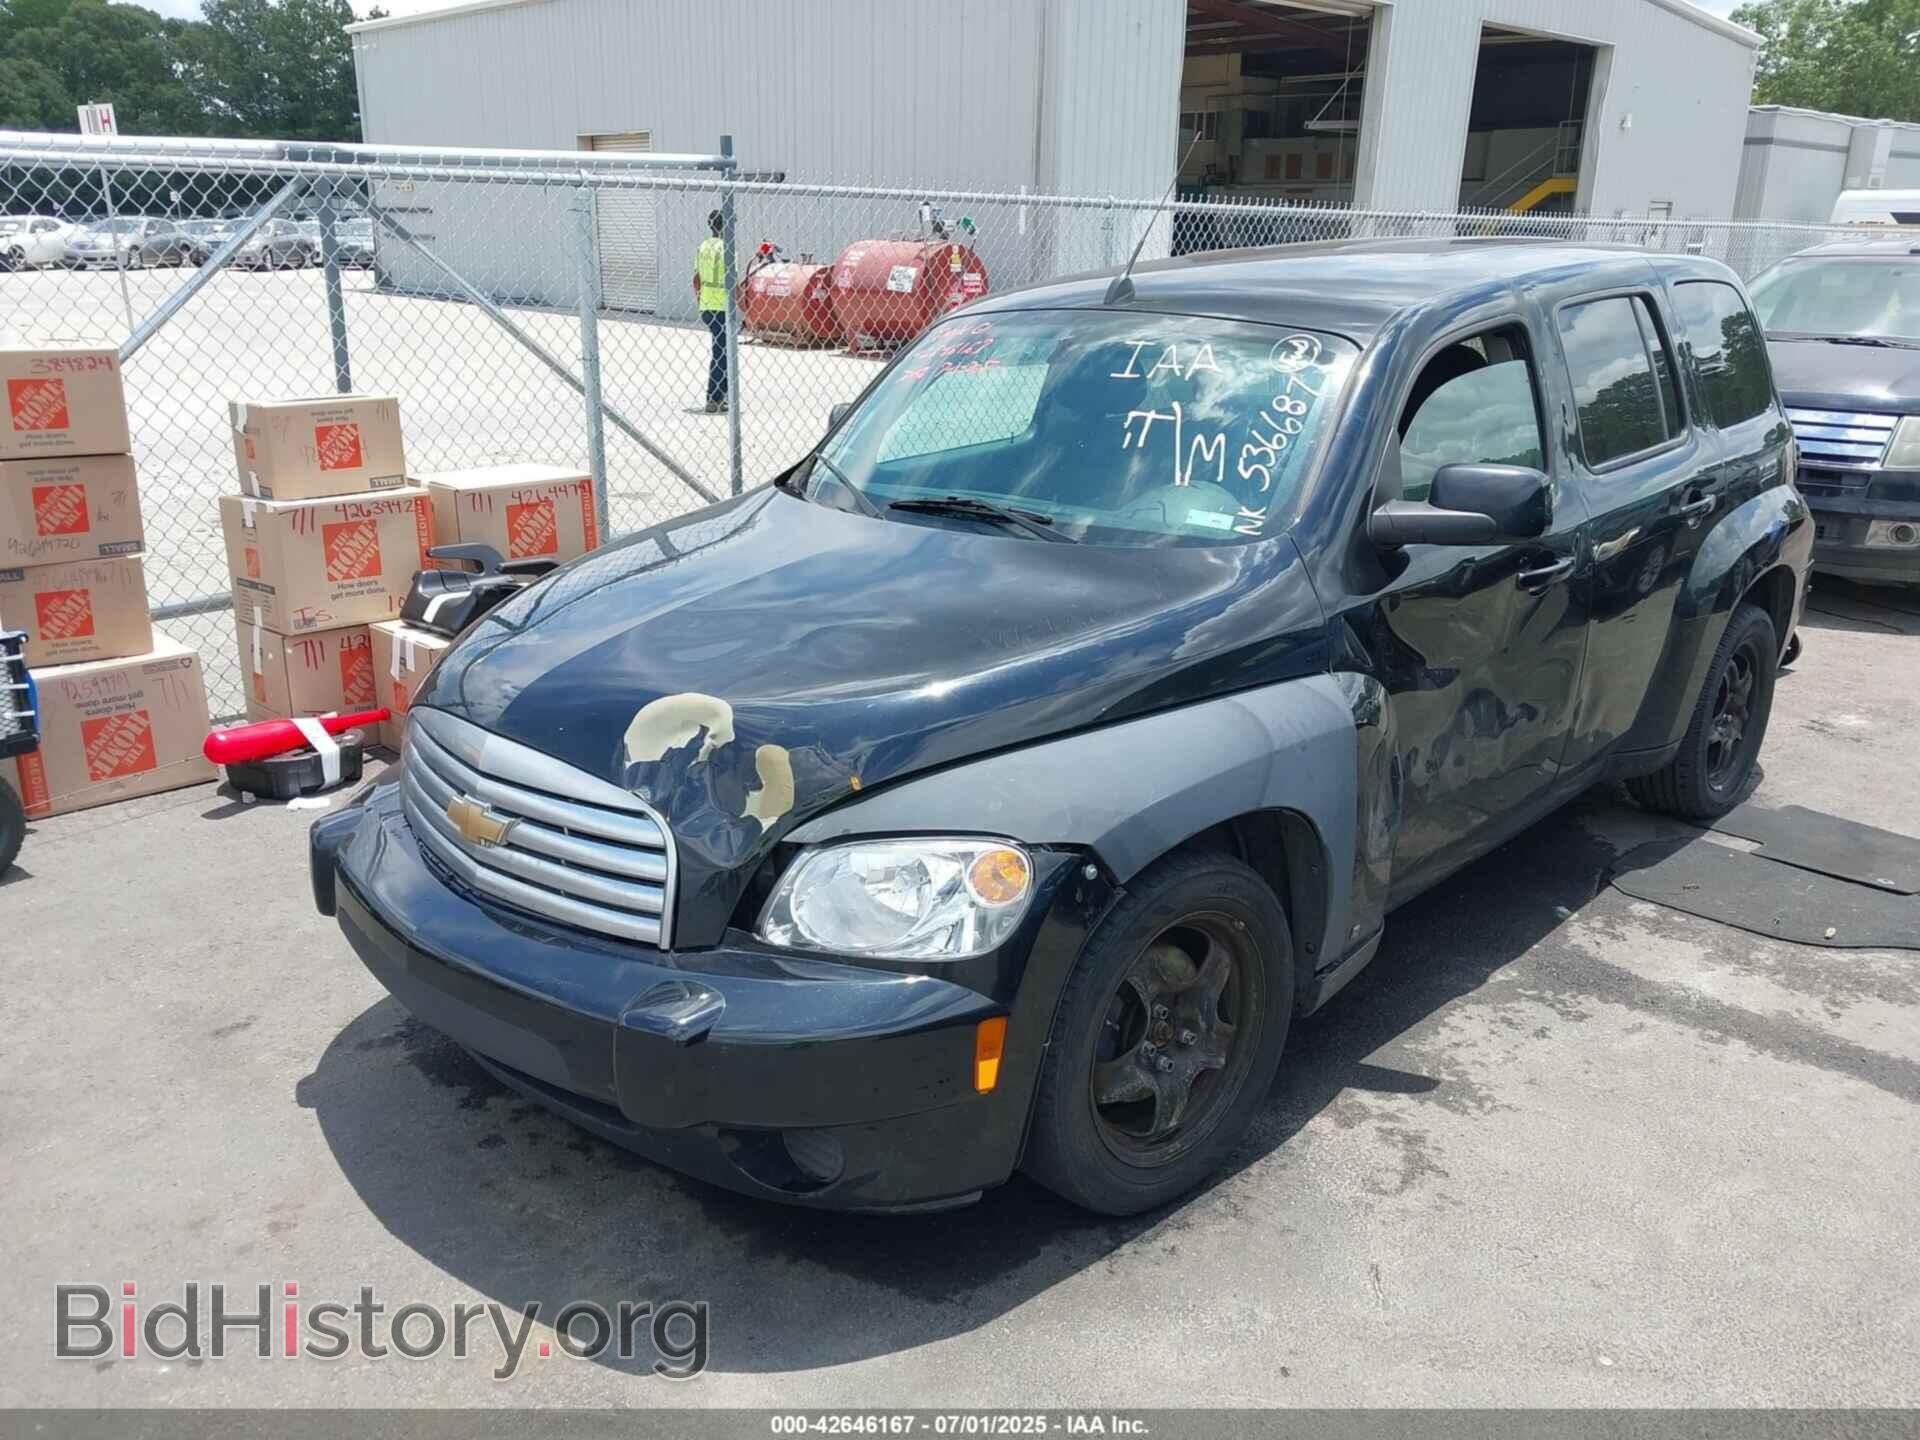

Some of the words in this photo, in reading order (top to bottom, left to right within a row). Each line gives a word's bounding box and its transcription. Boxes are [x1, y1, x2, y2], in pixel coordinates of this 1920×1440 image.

[1110, 341, 1224, 381] IAA
[1237, 376, 1324, 492] 536687
[331, 528, 351, 552] THE
[510, 503, 556, 558] HOME
[513, 510, 531, 531] THE
[328, 520, 378, 580] HOME
[349, 540, 380, 579] DEPOT
[40, 592, 87, 640] HOME
[85, 715, 122, 760] DEPOT
[90, 713, 151, 777] HOME
[121, 742, 147, 768] THE
